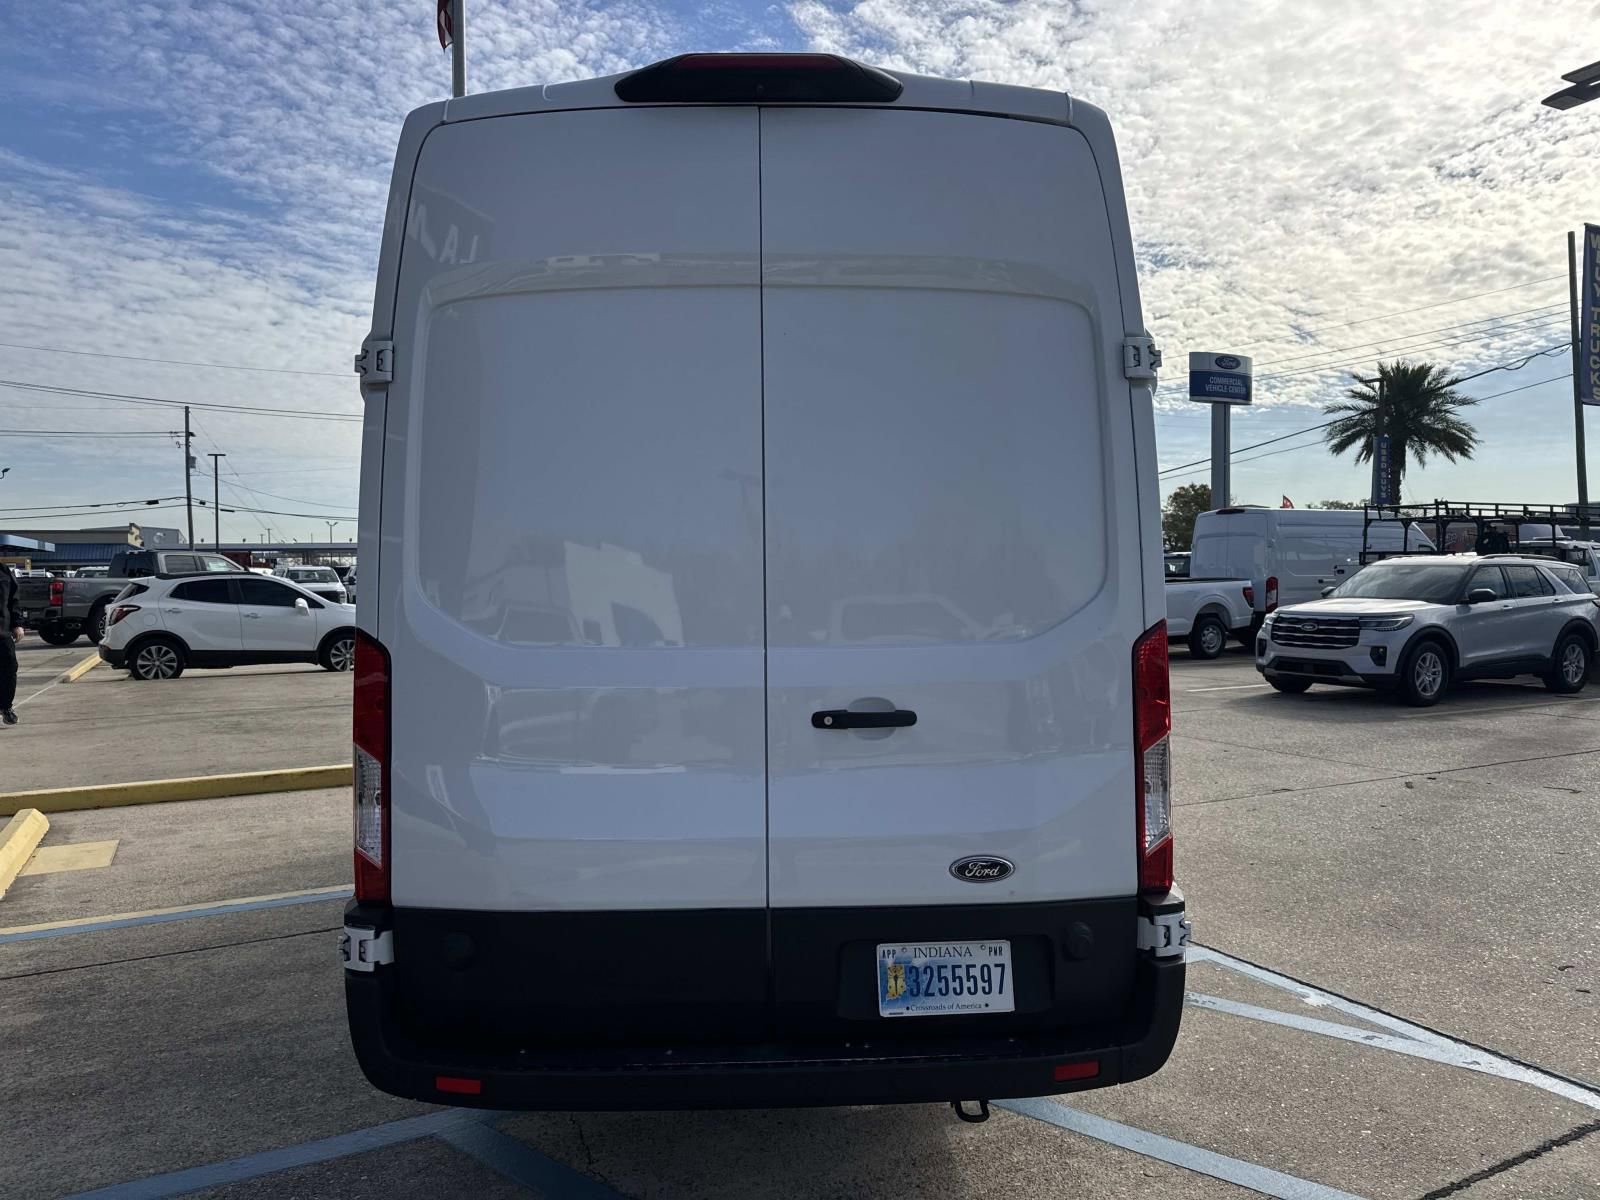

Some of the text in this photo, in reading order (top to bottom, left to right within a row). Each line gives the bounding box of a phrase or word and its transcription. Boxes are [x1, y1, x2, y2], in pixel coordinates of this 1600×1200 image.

[1209, 376, 1242, 386] COMMERCIAL
[1205, 384, 1228, 393] VEHICLE
[882, 946, 1003, 959] APP INDIANA PWR
[908, 963, 1006, 997] 3255597
[910, 1001, 982, 1011] Crossroads of America
